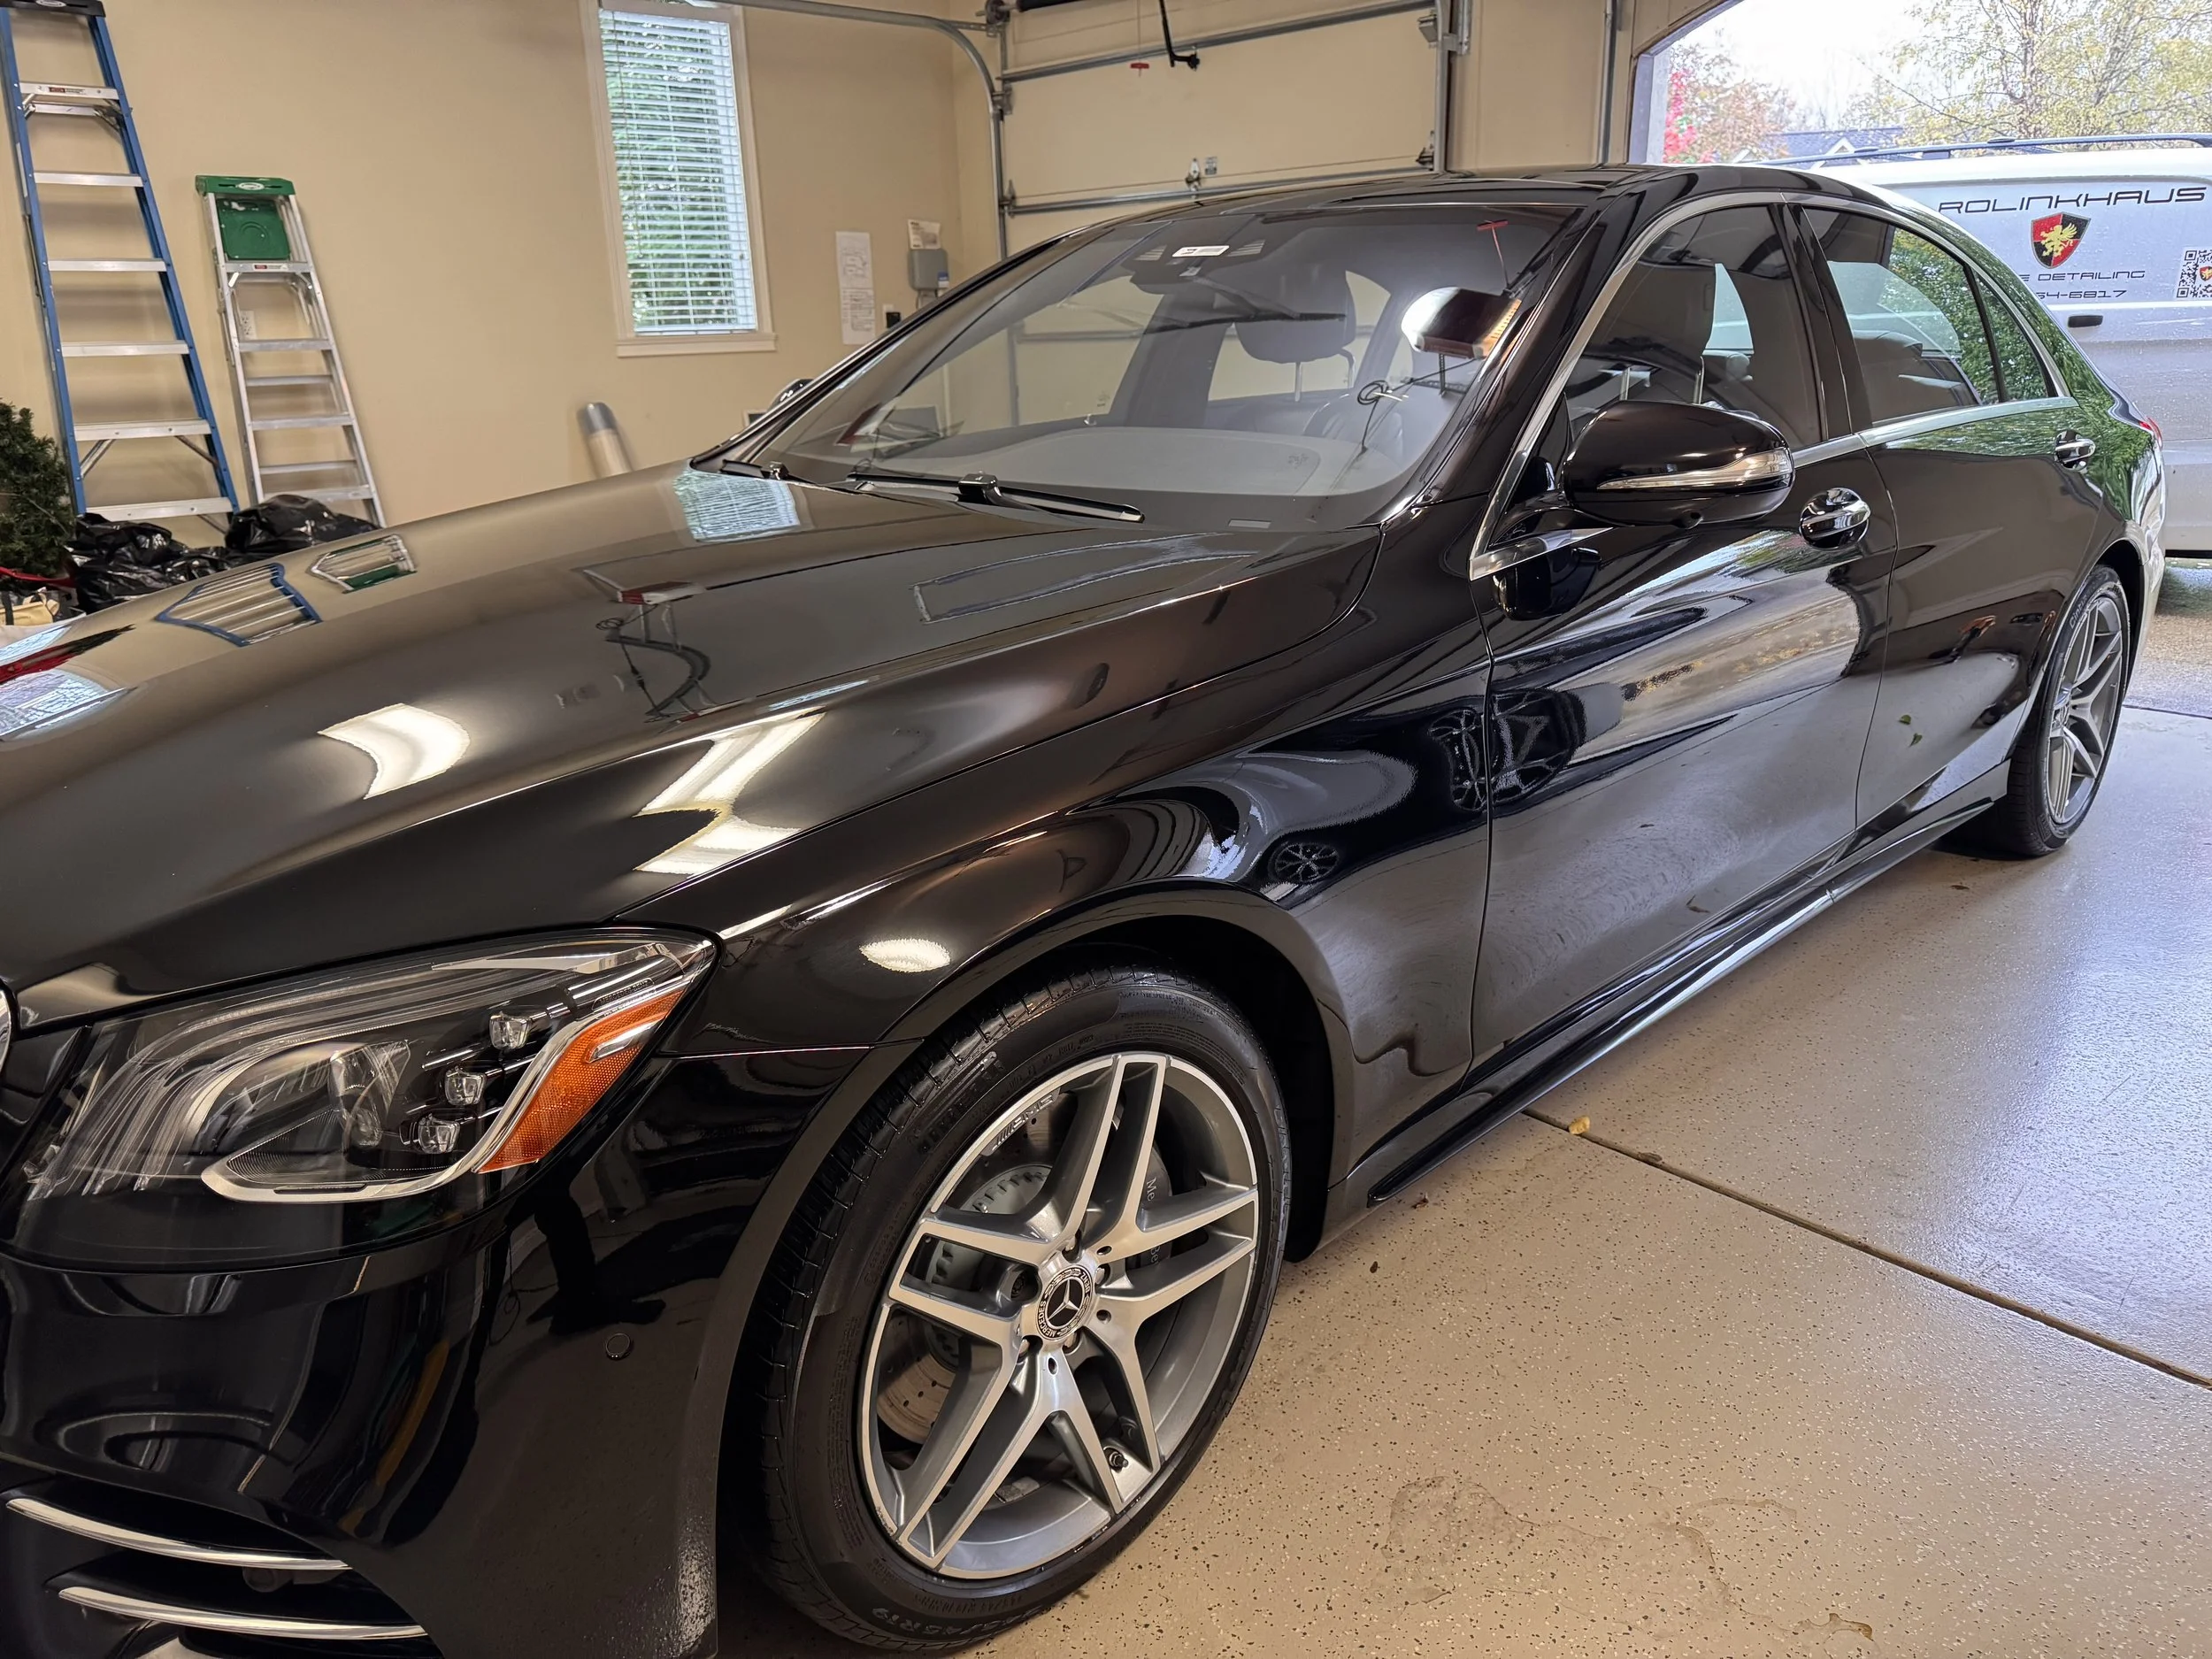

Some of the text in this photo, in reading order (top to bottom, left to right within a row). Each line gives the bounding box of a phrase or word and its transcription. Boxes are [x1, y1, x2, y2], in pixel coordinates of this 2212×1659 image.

[1939, 187, 2207, 214] ROLINKHAUS
[2038, 270, 2146, 281] DETAILING
[1079, 1271, 1092, 1294] BENZ
[1038, 1300, 1058, 1338] MERCEDES
